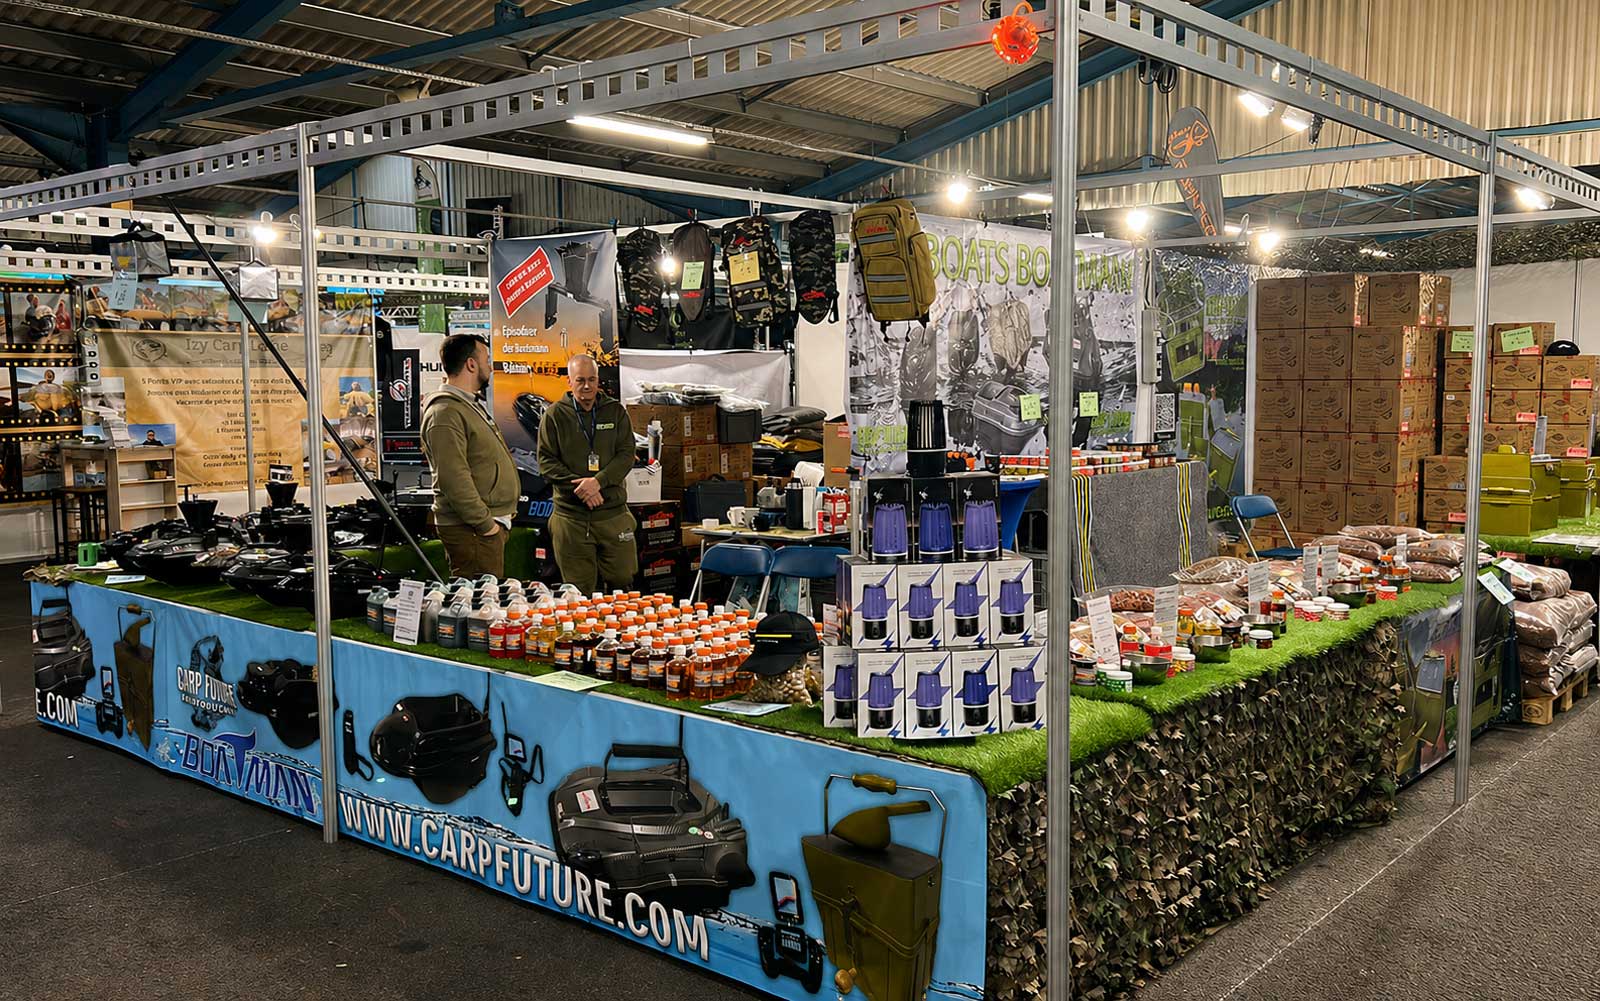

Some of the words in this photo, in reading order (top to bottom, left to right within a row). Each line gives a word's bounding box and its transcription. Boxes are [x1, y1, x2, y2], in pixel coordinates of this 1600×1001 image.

[925, 233, 1009, 286] BOATS
[1016, 243, 1134, 295] BOTMAN
[185, 338, 208, 353] Izy
[420, 362, 442, 372] HU
[34, 687, 79, 728] E.COM
[177, 666, 202, 695] CARP
[205, 674, 237, 709] FUTURE
[181, 727, 317, 815] BOATMAN
[339, 793, 709, 961] WWW.CARPFUTURE.COM
